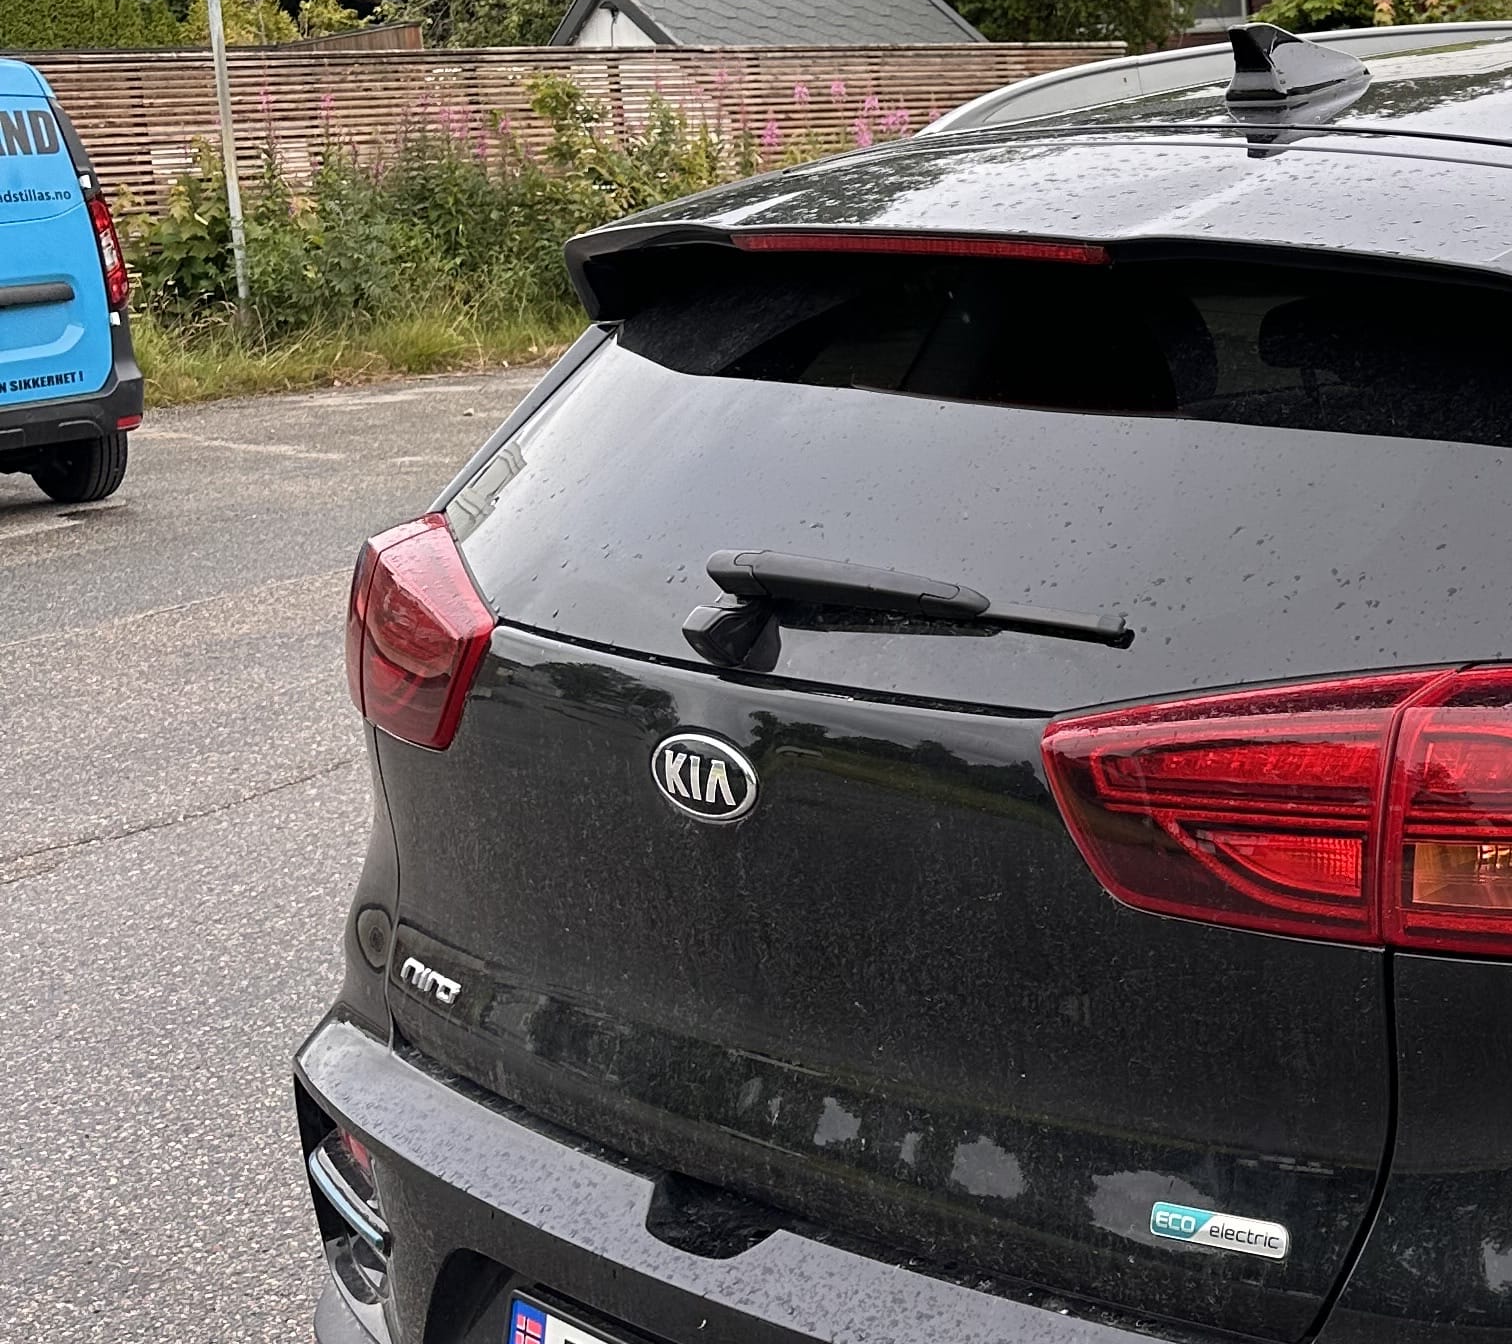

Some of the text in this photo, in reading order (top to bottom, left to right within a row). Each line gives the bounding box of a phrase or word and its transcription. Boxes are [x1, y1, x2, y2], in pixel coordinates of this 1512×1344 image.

[0, 110, 60, 156] ND
[0, 189, 72, 203] dstillas.no
[9, 371, 77, 392] SIKKERHET
[663, 748, 737, 807] KIA
[1155, 1210, 1280, 1250] ECO electric
